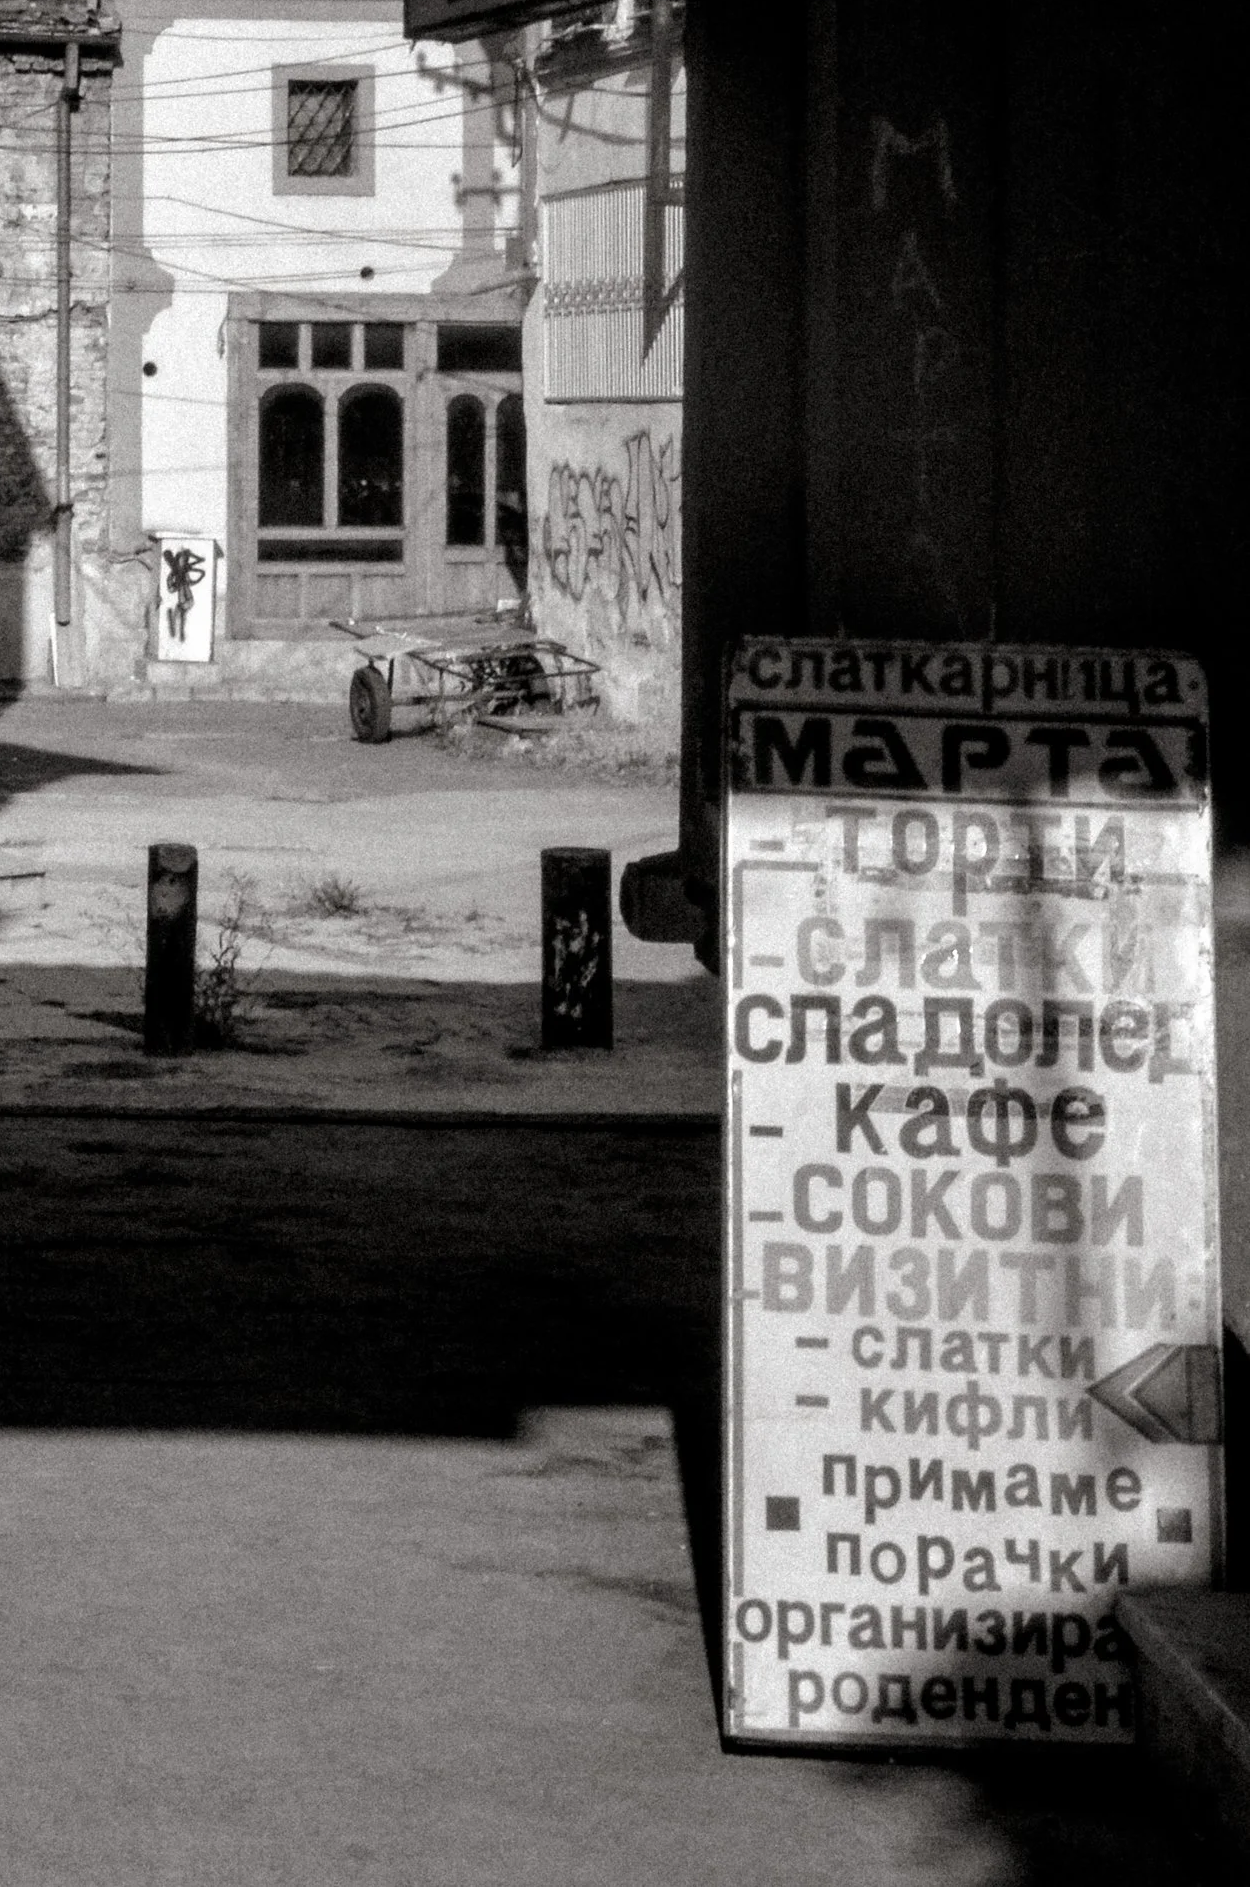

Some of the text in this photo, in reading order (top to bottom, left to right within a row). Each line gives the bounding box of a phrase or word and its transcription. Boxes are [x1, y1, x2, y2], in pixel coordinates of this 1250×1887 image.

[748, 646, 1184, 713] слаткарница
[835, 1077, 1107, 1168] кафе
[850, 1324, 1096, 1381] слатки
[859, 1379, 1095, 1451] кифли
[822, 1453, 1144, 1526] примаме
[825, 1531, 1130, 1596] порачки
[787, 1667, 1136, 1730] роденден
